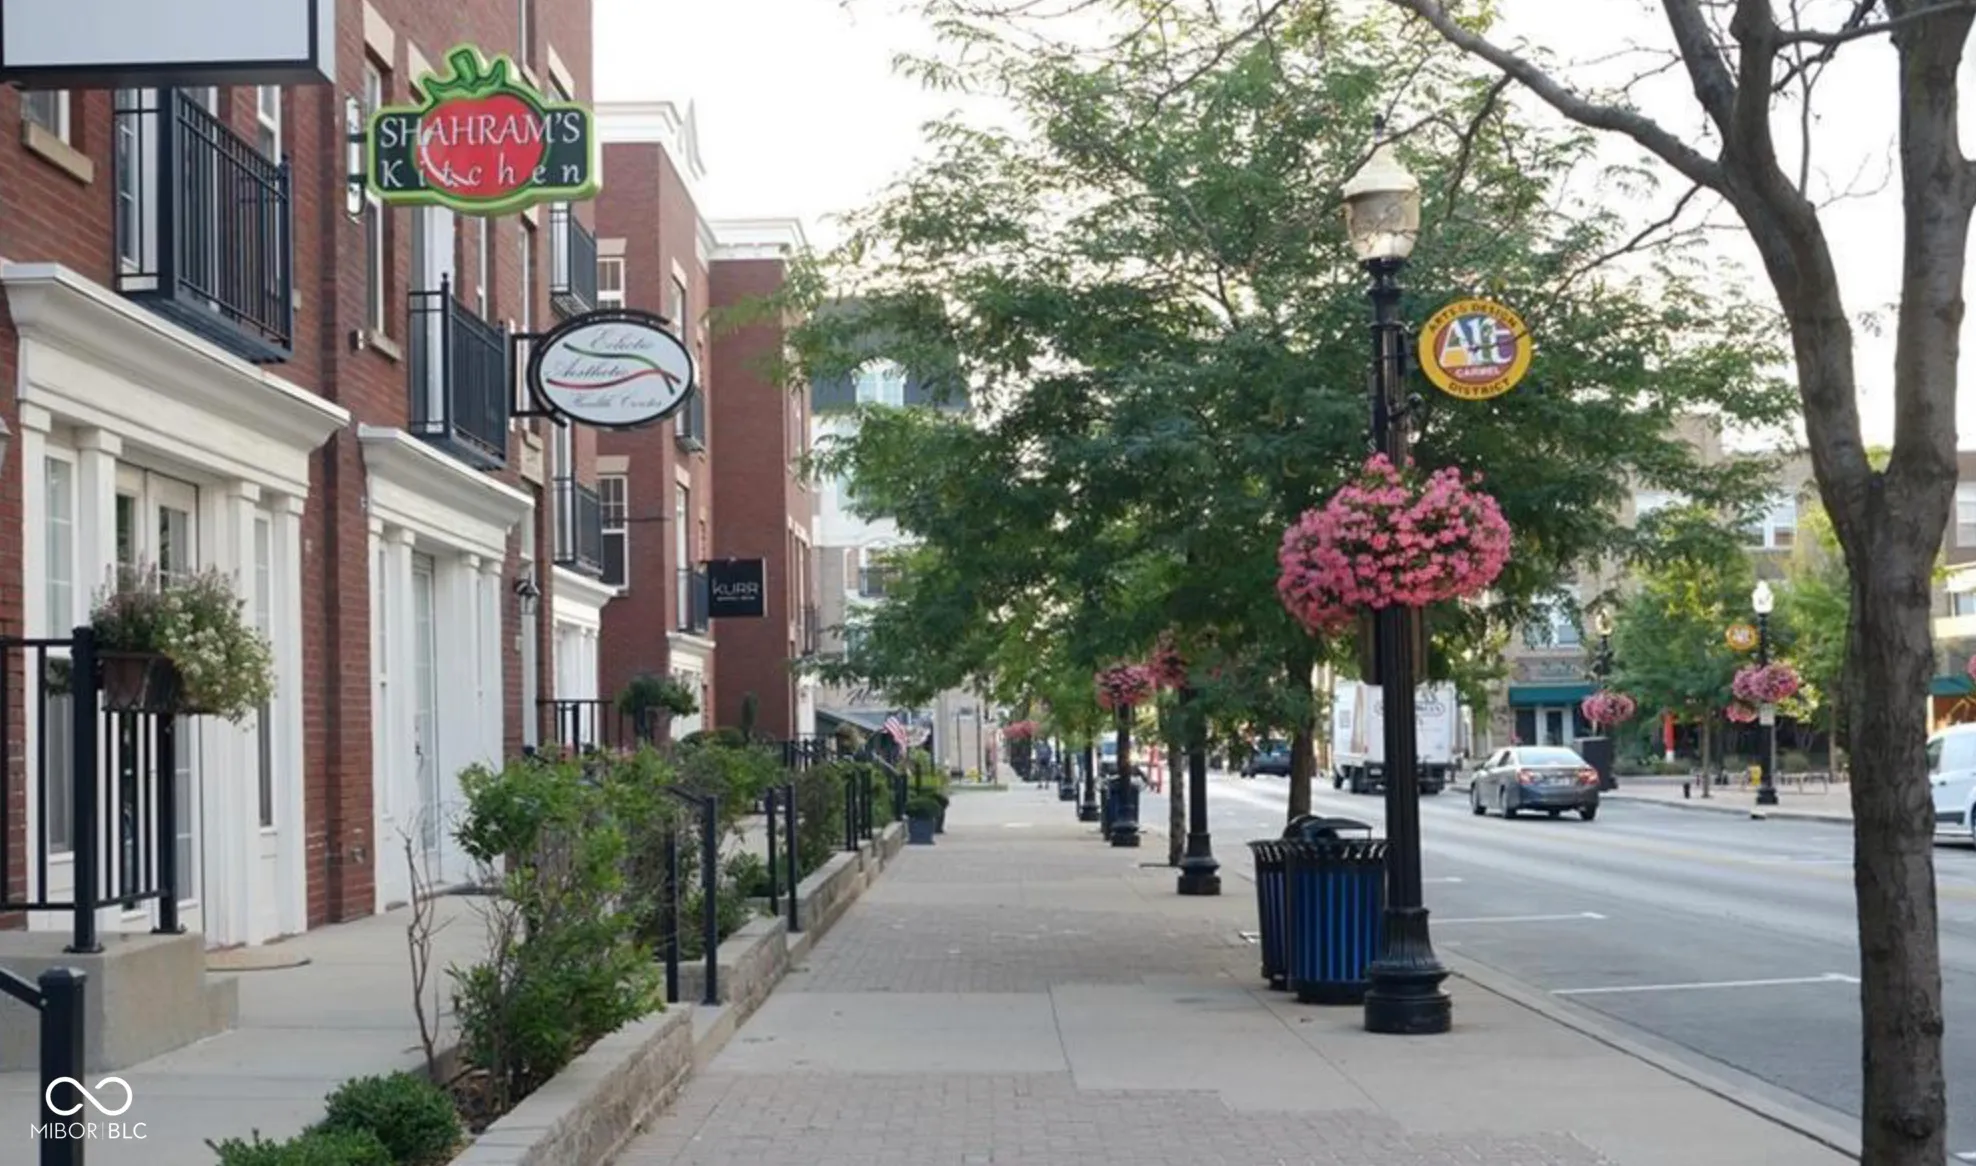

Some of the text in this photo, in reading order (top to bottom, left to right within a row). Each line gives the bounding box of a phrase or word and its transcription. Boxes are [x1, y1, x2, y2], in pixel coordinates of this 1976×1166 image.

[380, 112, 580, 149] SHAHRAM'S
[381, 153, 581, 188] Kitchen
[1471, 303, 1517, 328] DESIGN
[1454, 367, 1500, 379] CARMEL
[1447, 378, 1510, 396] DISTRICT
